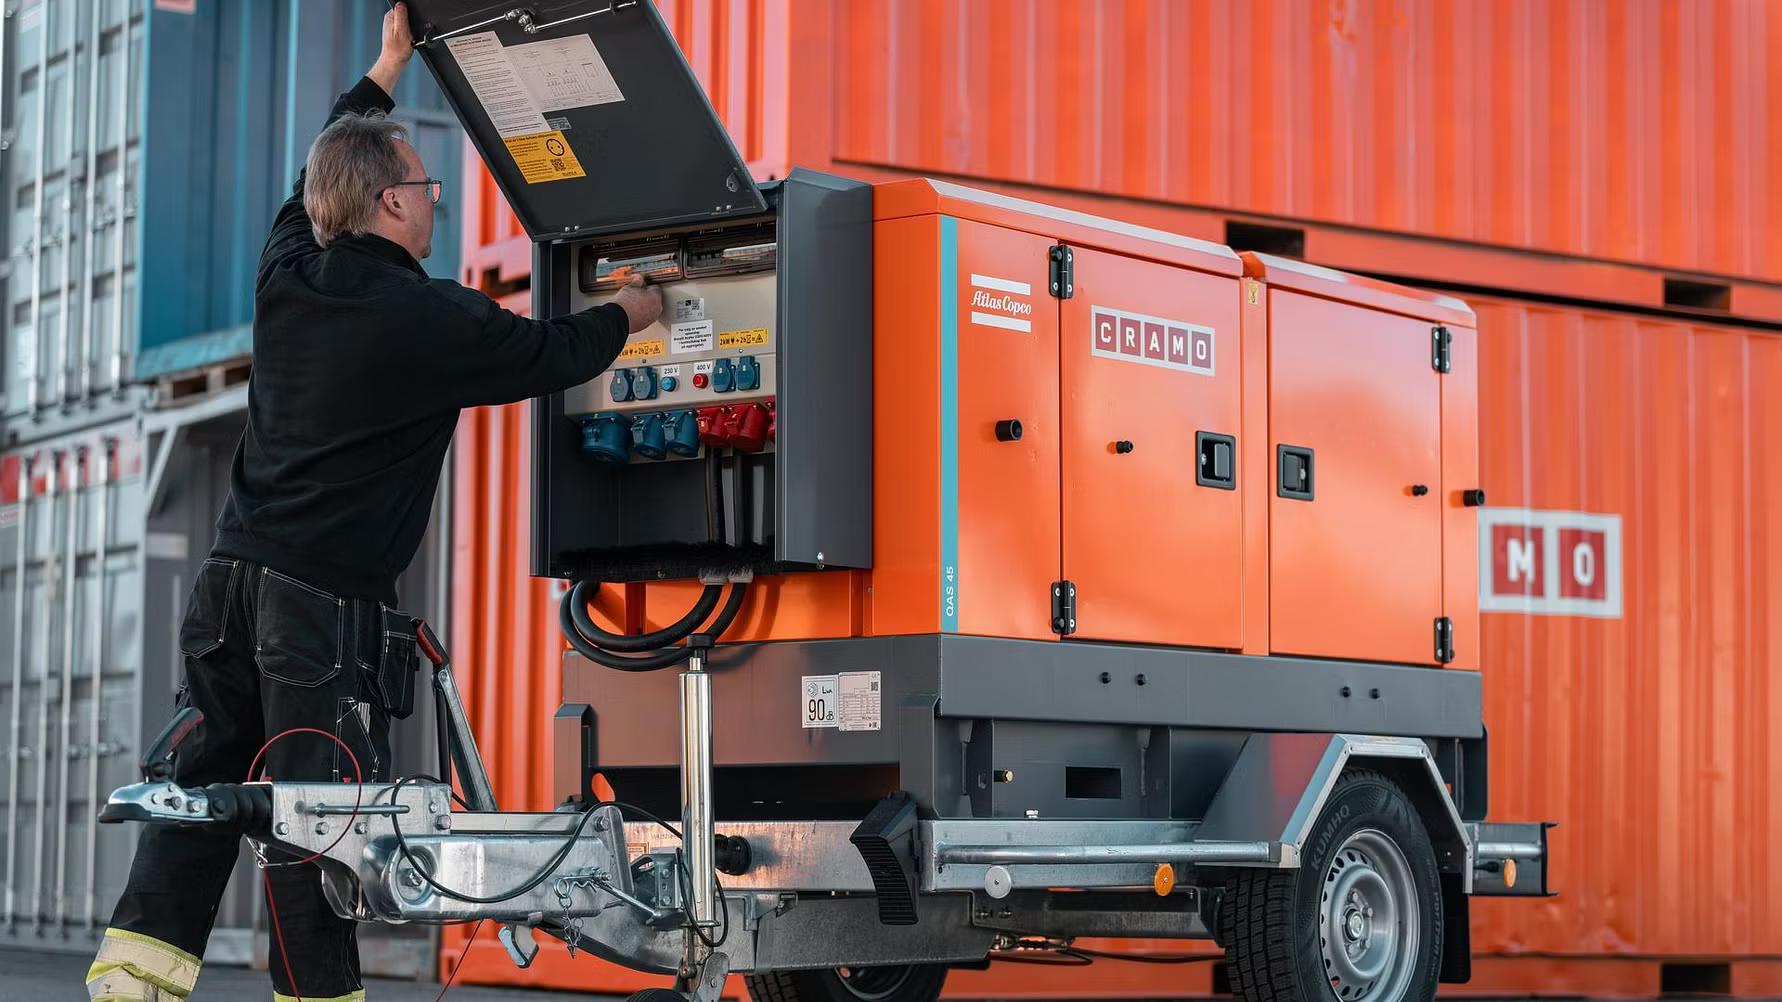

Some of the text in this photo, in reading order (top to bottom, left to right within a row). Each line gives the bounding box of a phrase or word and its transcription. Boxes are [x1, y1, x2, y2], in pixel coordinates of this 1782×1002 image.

[1100, 321, 1207, 361] CRAMO
[945, 566, 954, 617] QAS 45
[808, 698, 835, 721] 90 dB
[1310, 804, 1350, 872] KUMHO
